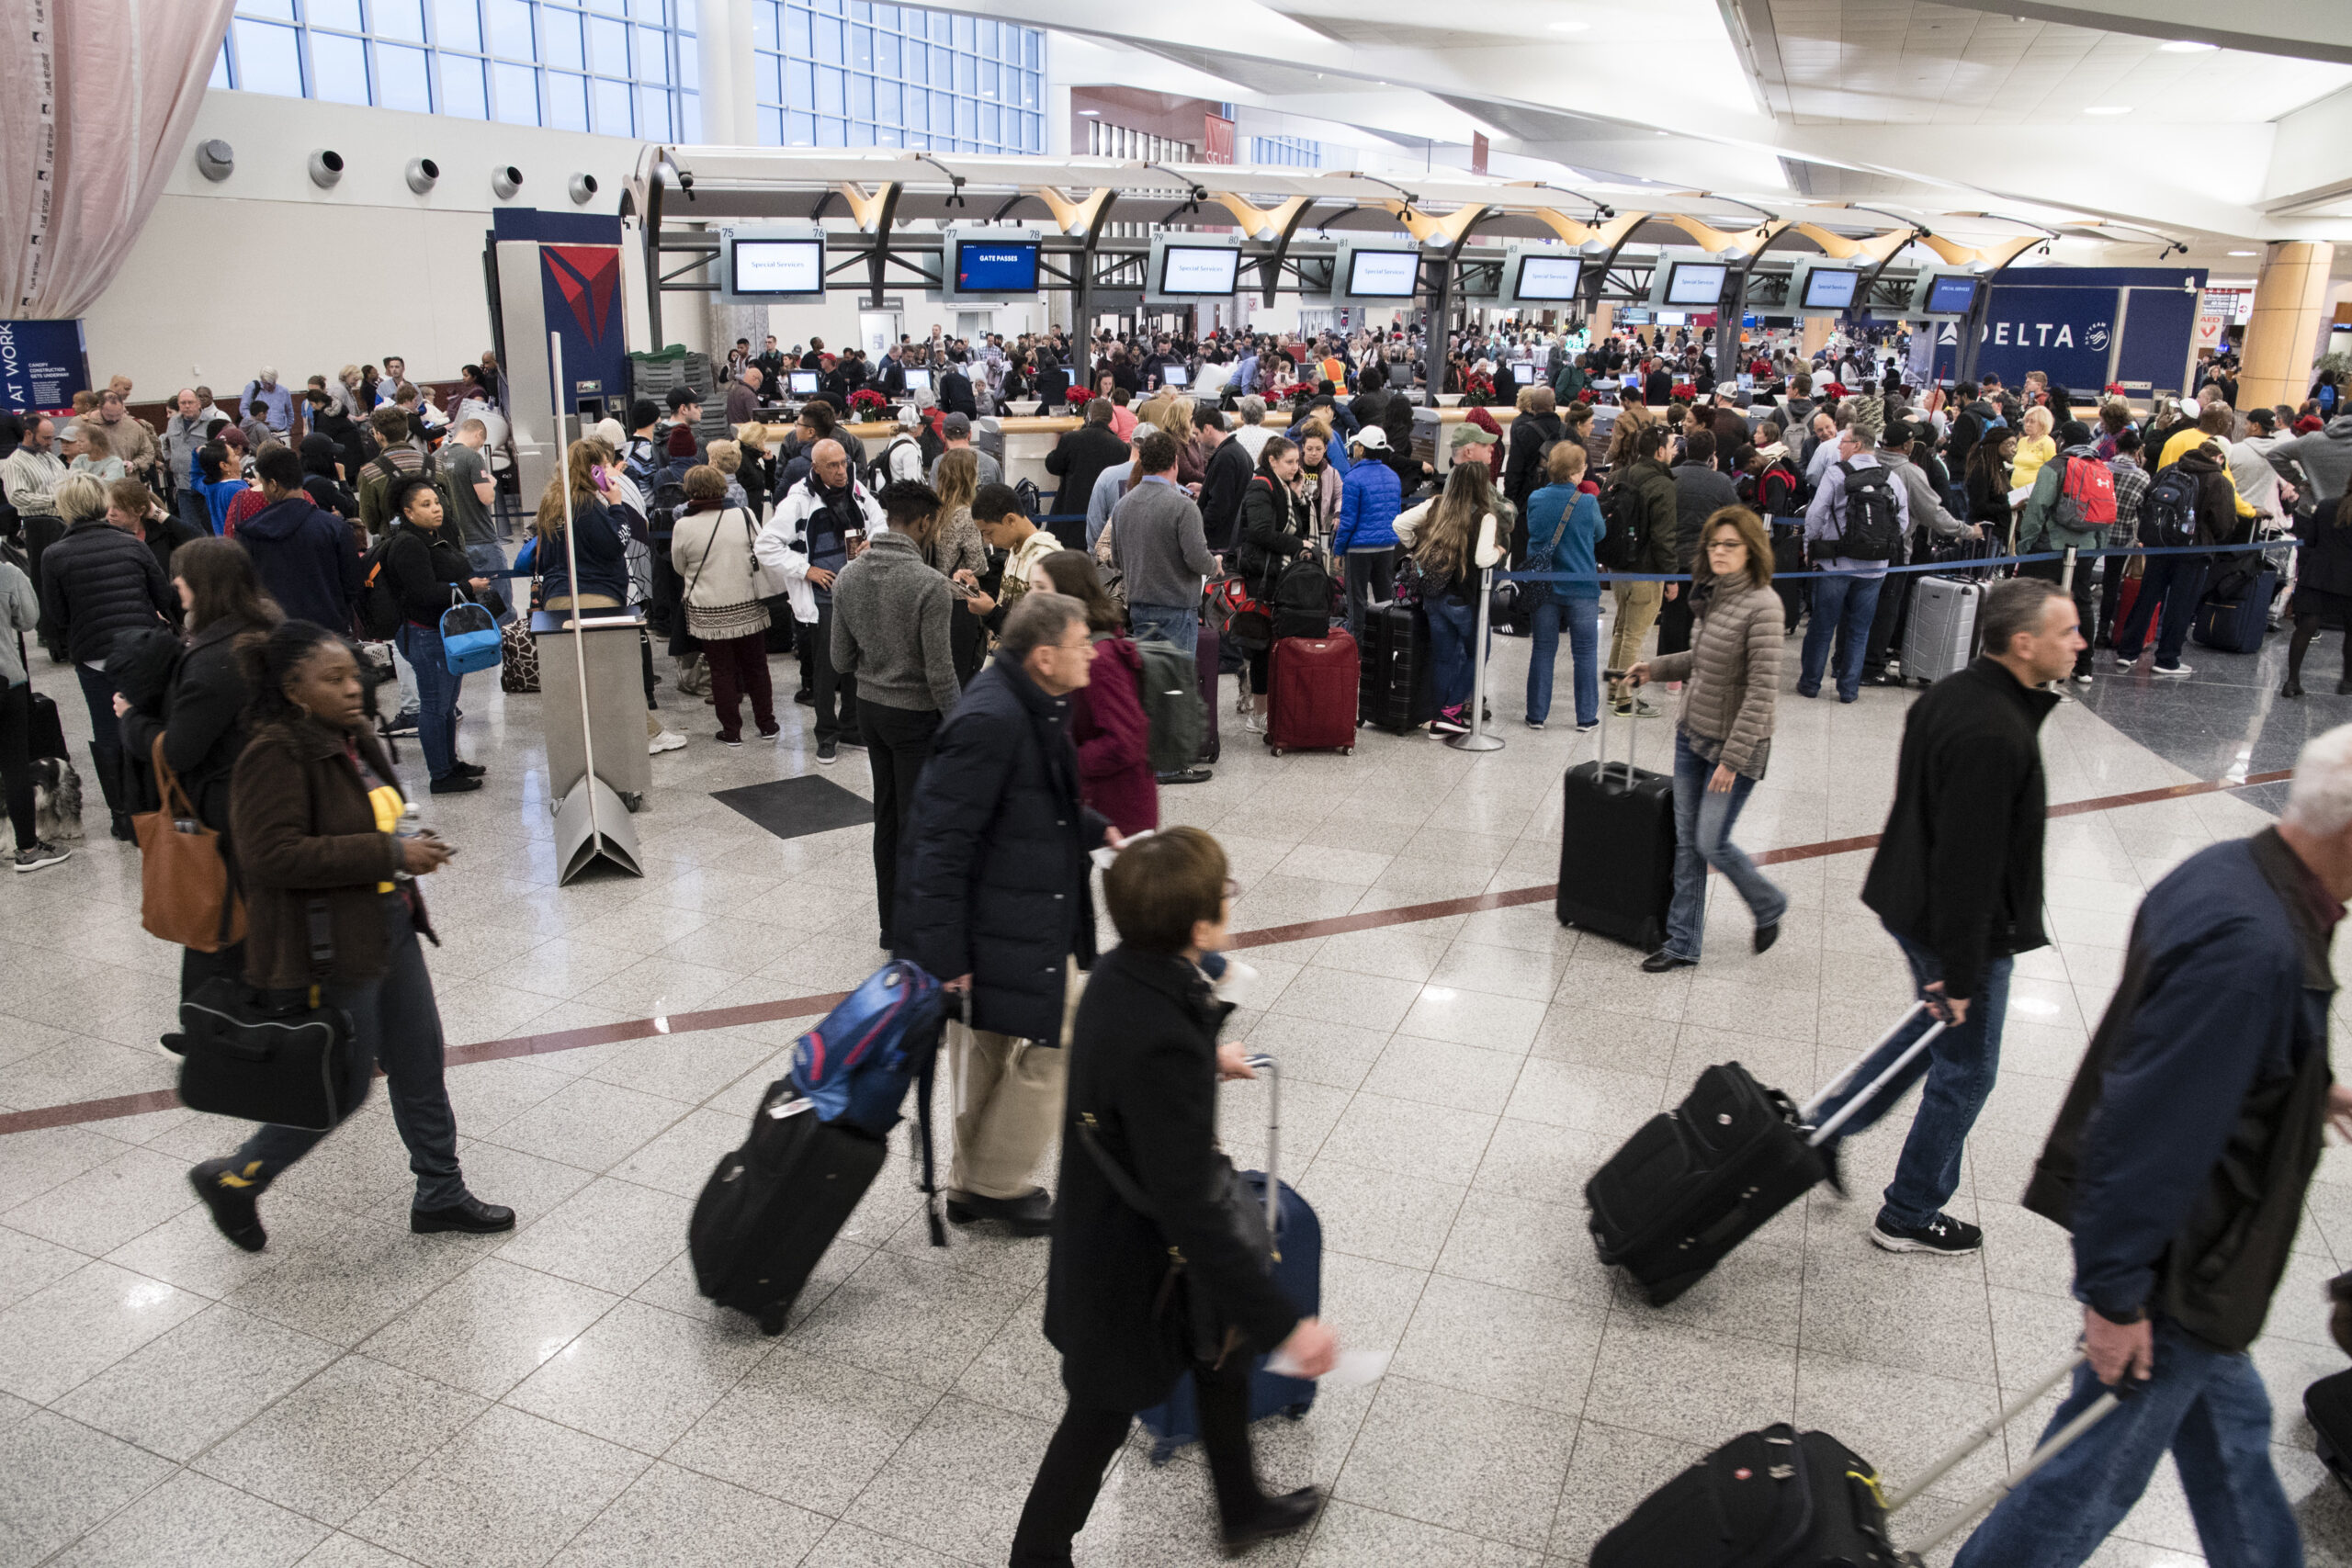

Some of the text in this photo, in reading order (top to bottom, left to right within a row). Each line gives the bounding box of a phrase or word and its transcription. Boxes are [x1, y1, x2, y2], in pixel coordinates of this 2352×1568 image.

[722, 228, 734, 238] 75
[813, 228, 825, 238] 76
[946, 229, 957, 239] 77
[1029, 230, 1040, 239] 78
[1153, 233, 1164, 242] 79
[1228, 235, 1238, 244] 80
[1339, 239, 1348, 247] 81
[1408, 241, 1417, 250] 82
[1509, 244, 1518, 253] 83
[1568, 247, 1577, 255] 84
[0, 322, 19, 378] WORK
[7, 382, 26, 403] AT
